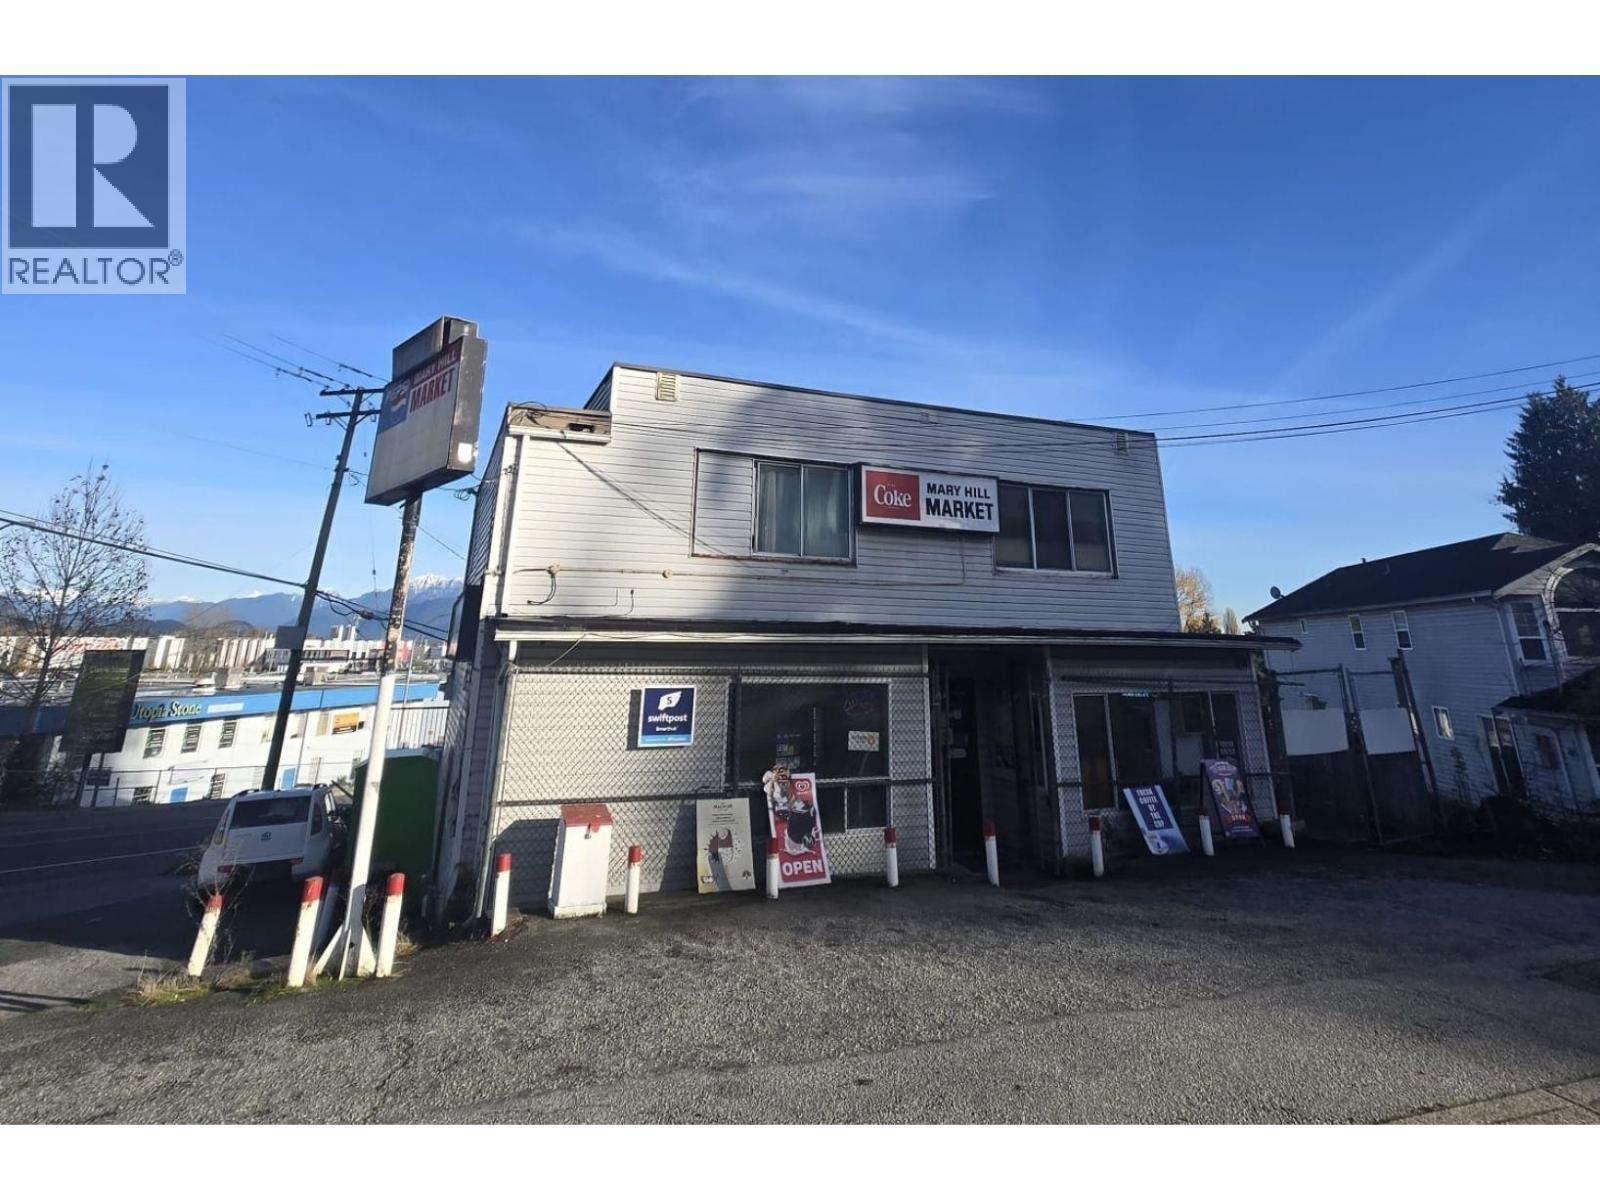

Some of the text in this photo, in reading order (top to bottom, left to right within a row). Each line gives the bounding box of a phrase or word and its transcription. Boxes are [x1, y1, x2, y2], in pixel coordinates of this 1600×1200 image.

[410, 367, 455, 413] MARKET
[874, 484, 911, 507] Coke
[926, 483, 990, 499] MARY HILL
[925, 498, 993, 520] MARKET
[648, 712, 688, 724] swiftpost
[782, 859, 823, 876] OPEN
